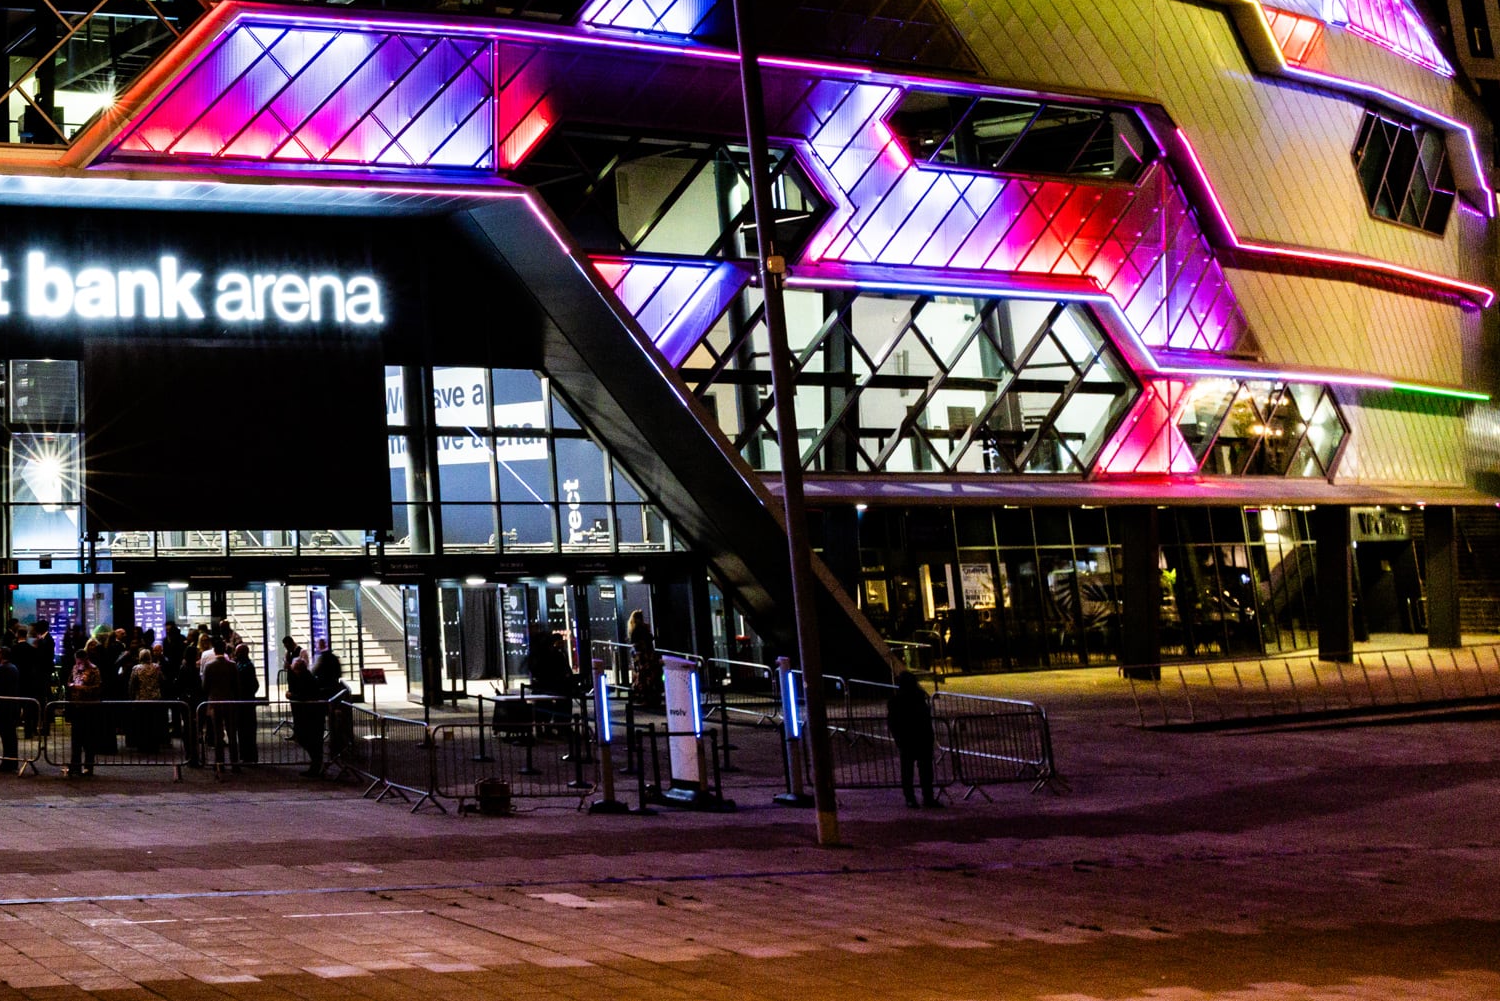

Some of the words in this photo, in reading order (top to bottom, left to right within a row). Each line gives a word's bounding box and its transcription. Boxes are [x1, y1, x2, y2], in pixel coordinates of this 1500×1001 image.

[26, 250, 205, 319] bank
[215, 272, 384, 324] arena
[434, 385, 465, 409] ave
[472, 384, 485, 406] a
